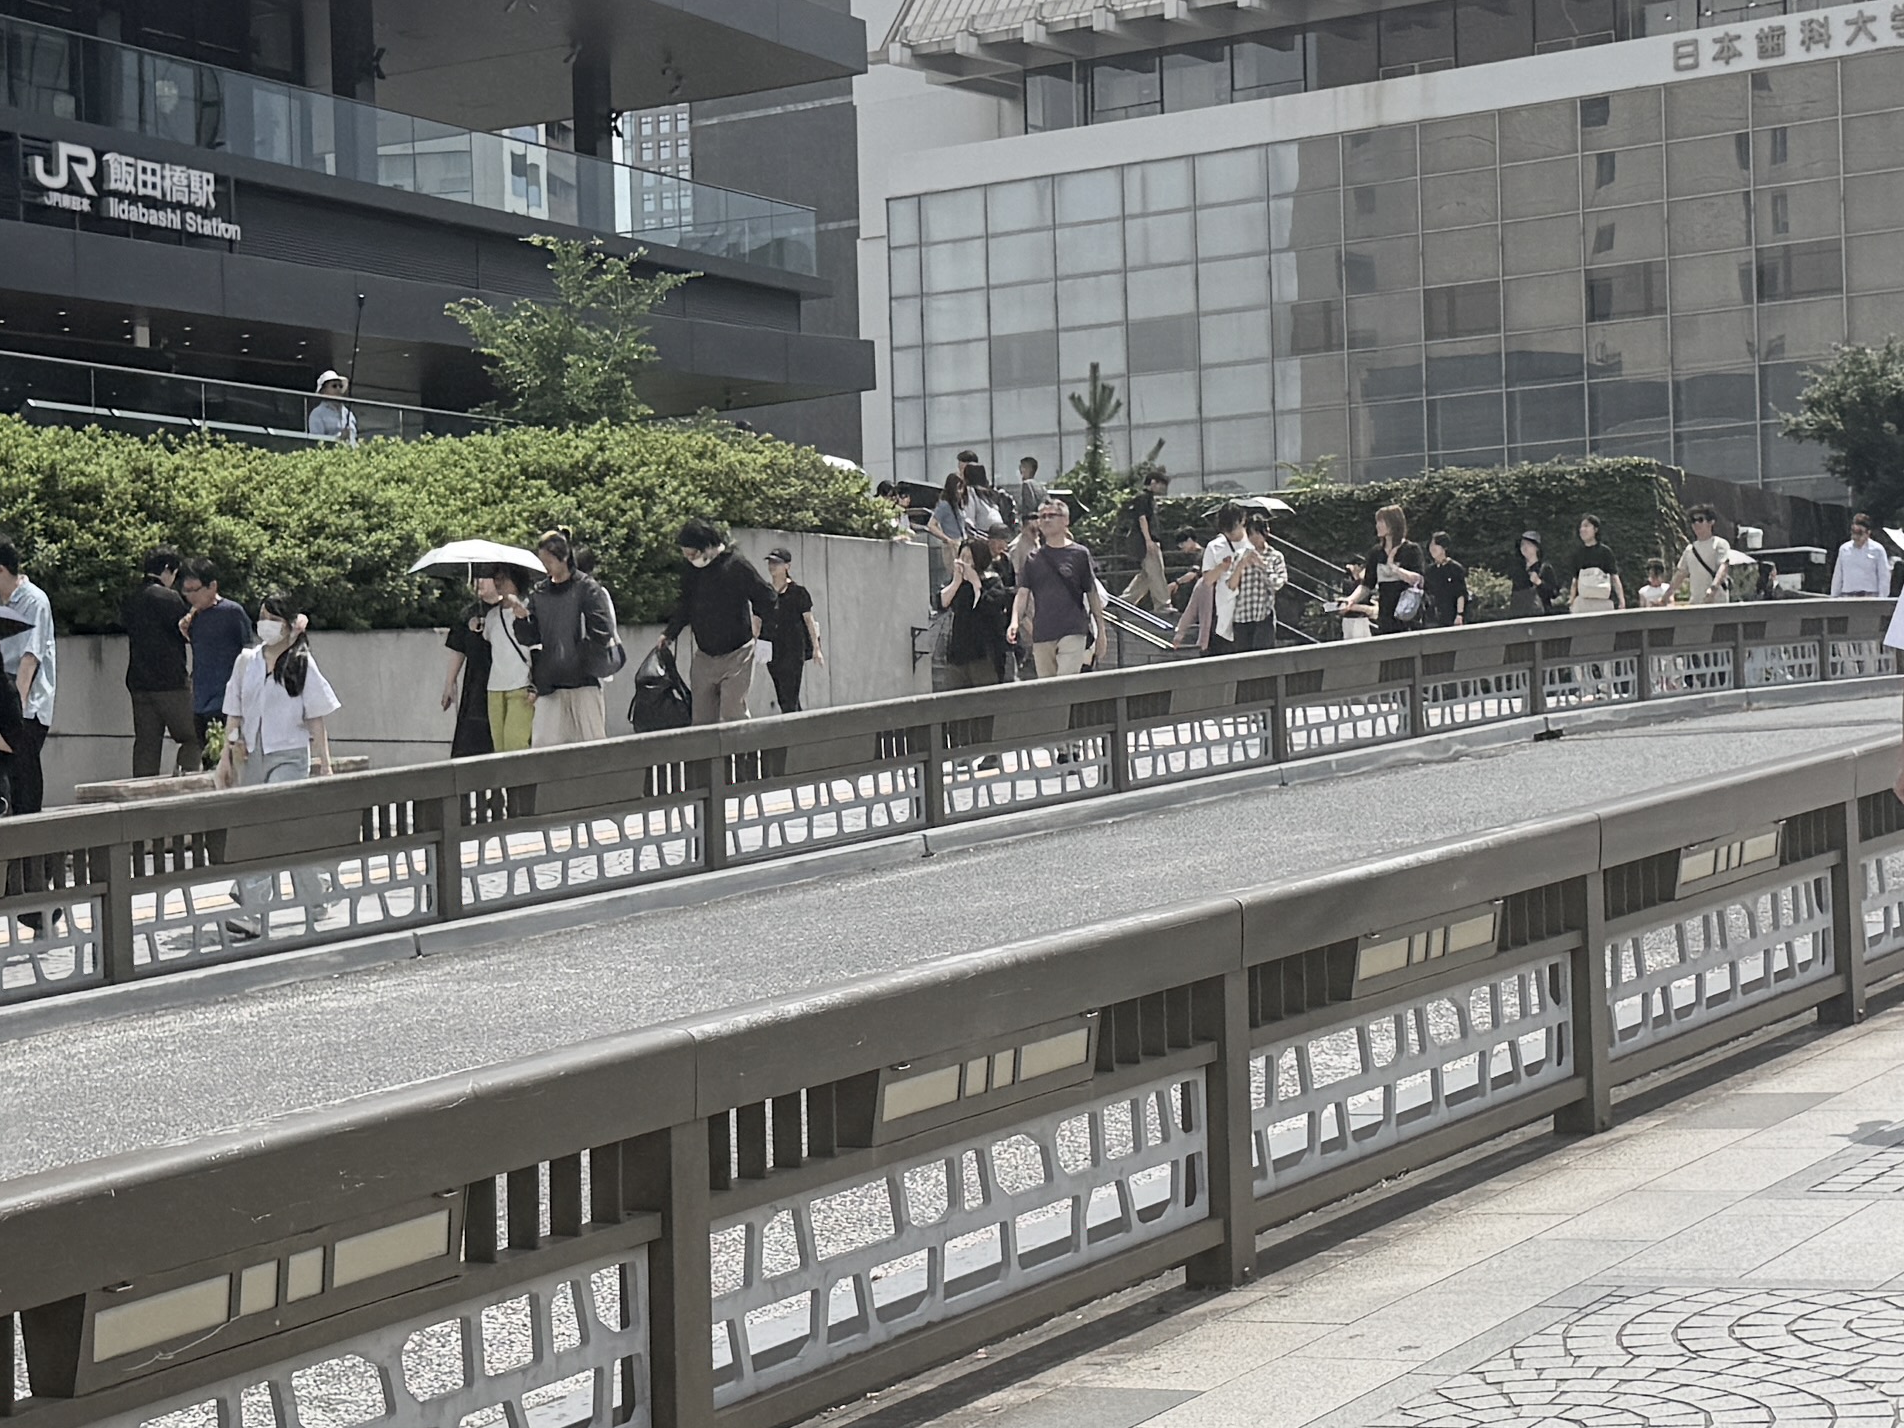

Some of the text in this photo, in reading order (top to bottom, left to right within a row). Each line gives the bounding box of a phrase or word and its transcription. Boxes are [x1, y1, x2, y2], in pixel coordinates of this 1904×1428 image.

[28, 140, 216, 210] JR 飯田橋駅
[185, 210, 241, 241] Station
